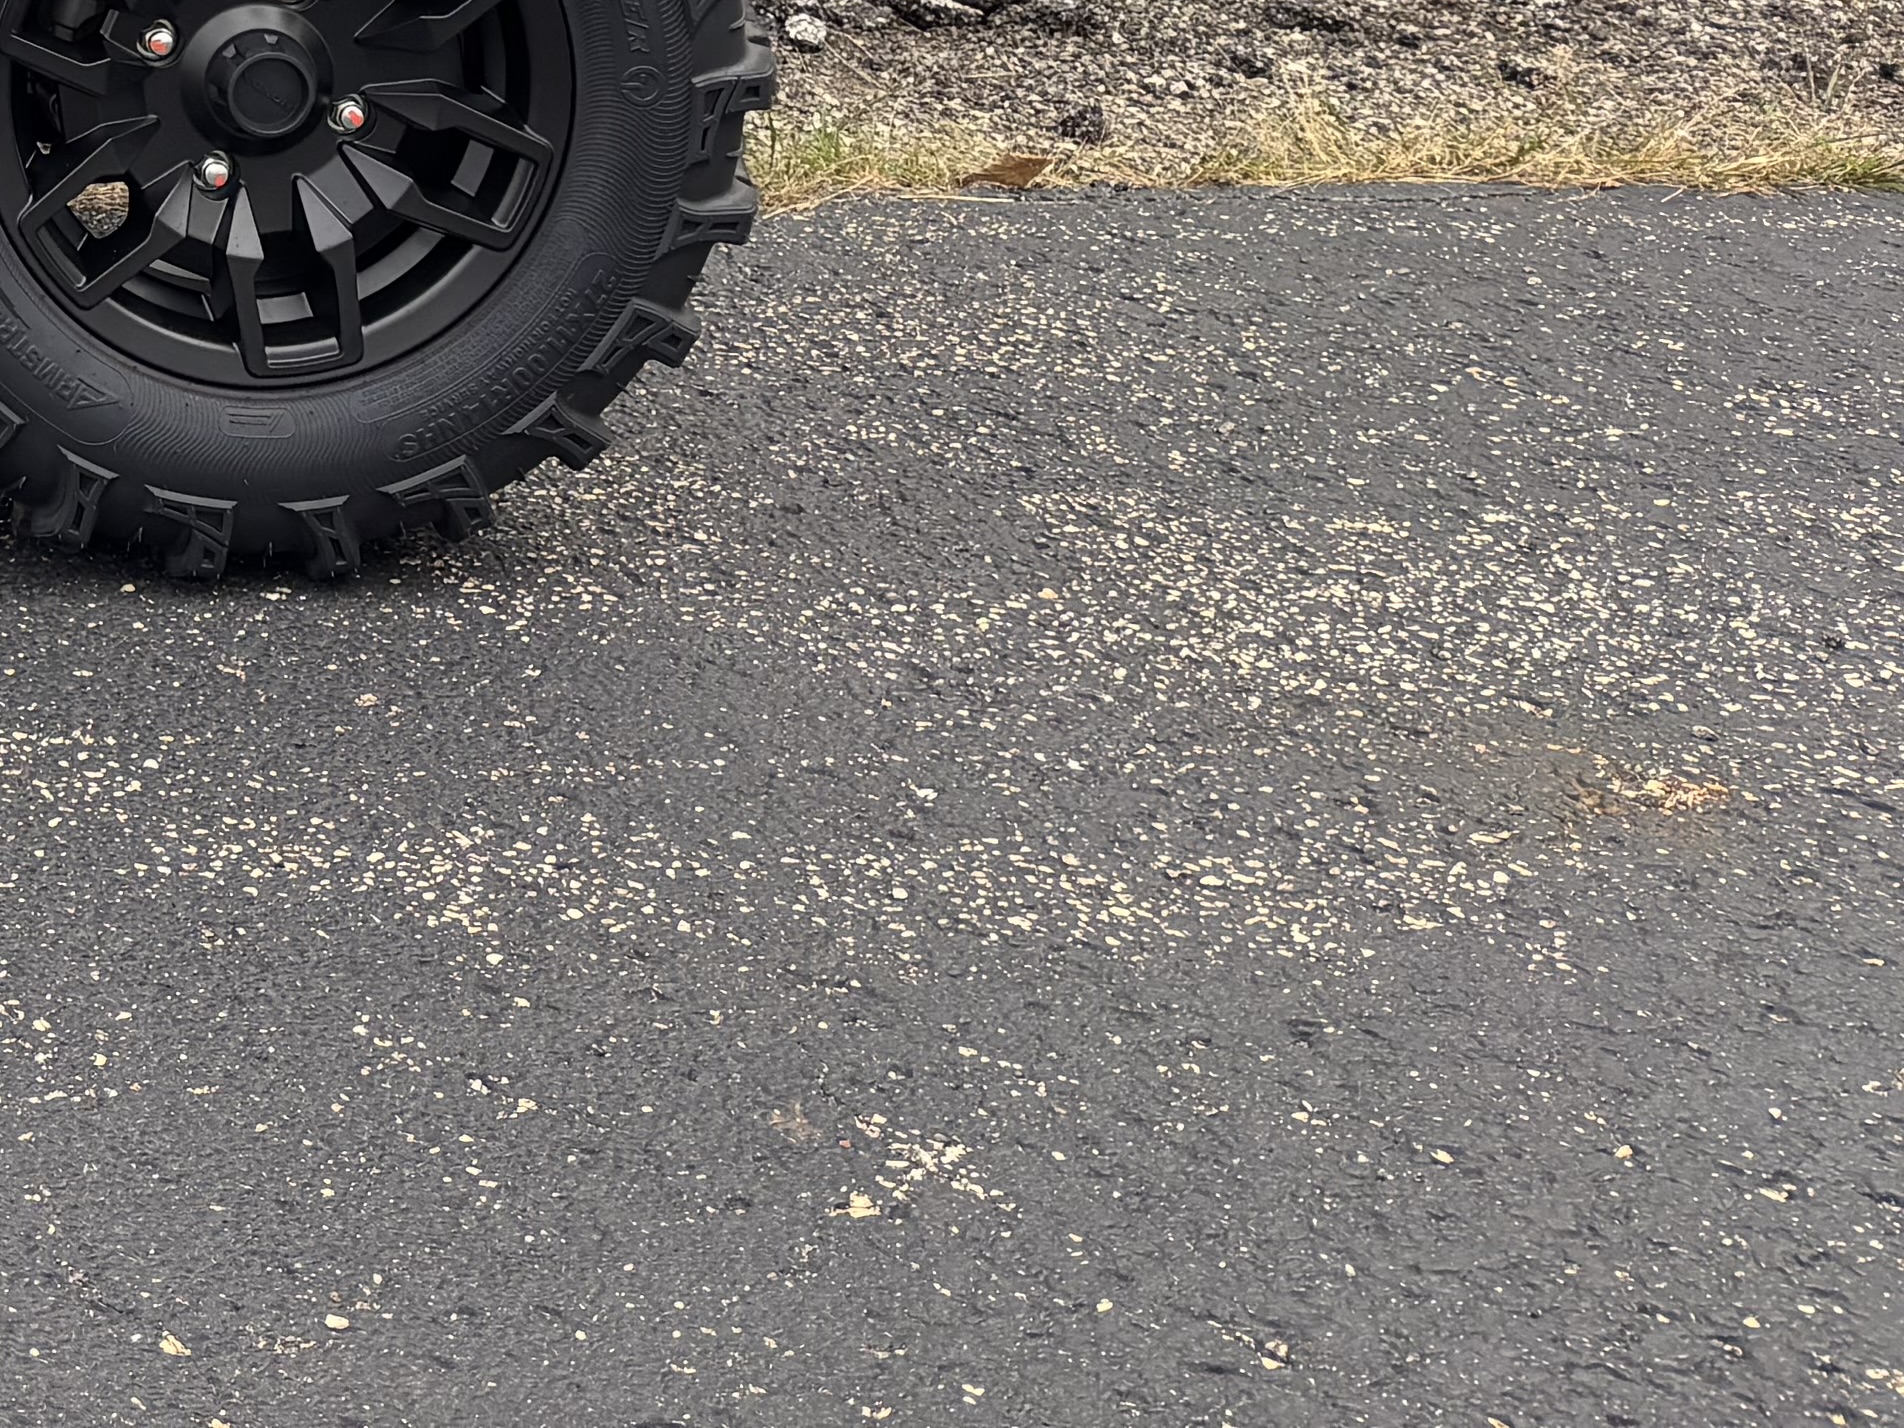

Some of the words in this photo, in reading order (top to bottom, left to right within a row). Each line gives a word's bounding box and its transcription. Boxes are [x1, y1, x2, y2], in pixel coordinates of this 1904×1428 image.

[551, 285, 577, 315] NOT
[530, 310, 559, 341] FOR
[477, 334, 537, 387] HIGHWAY
[417, 380, 481, 422] SERVICE
